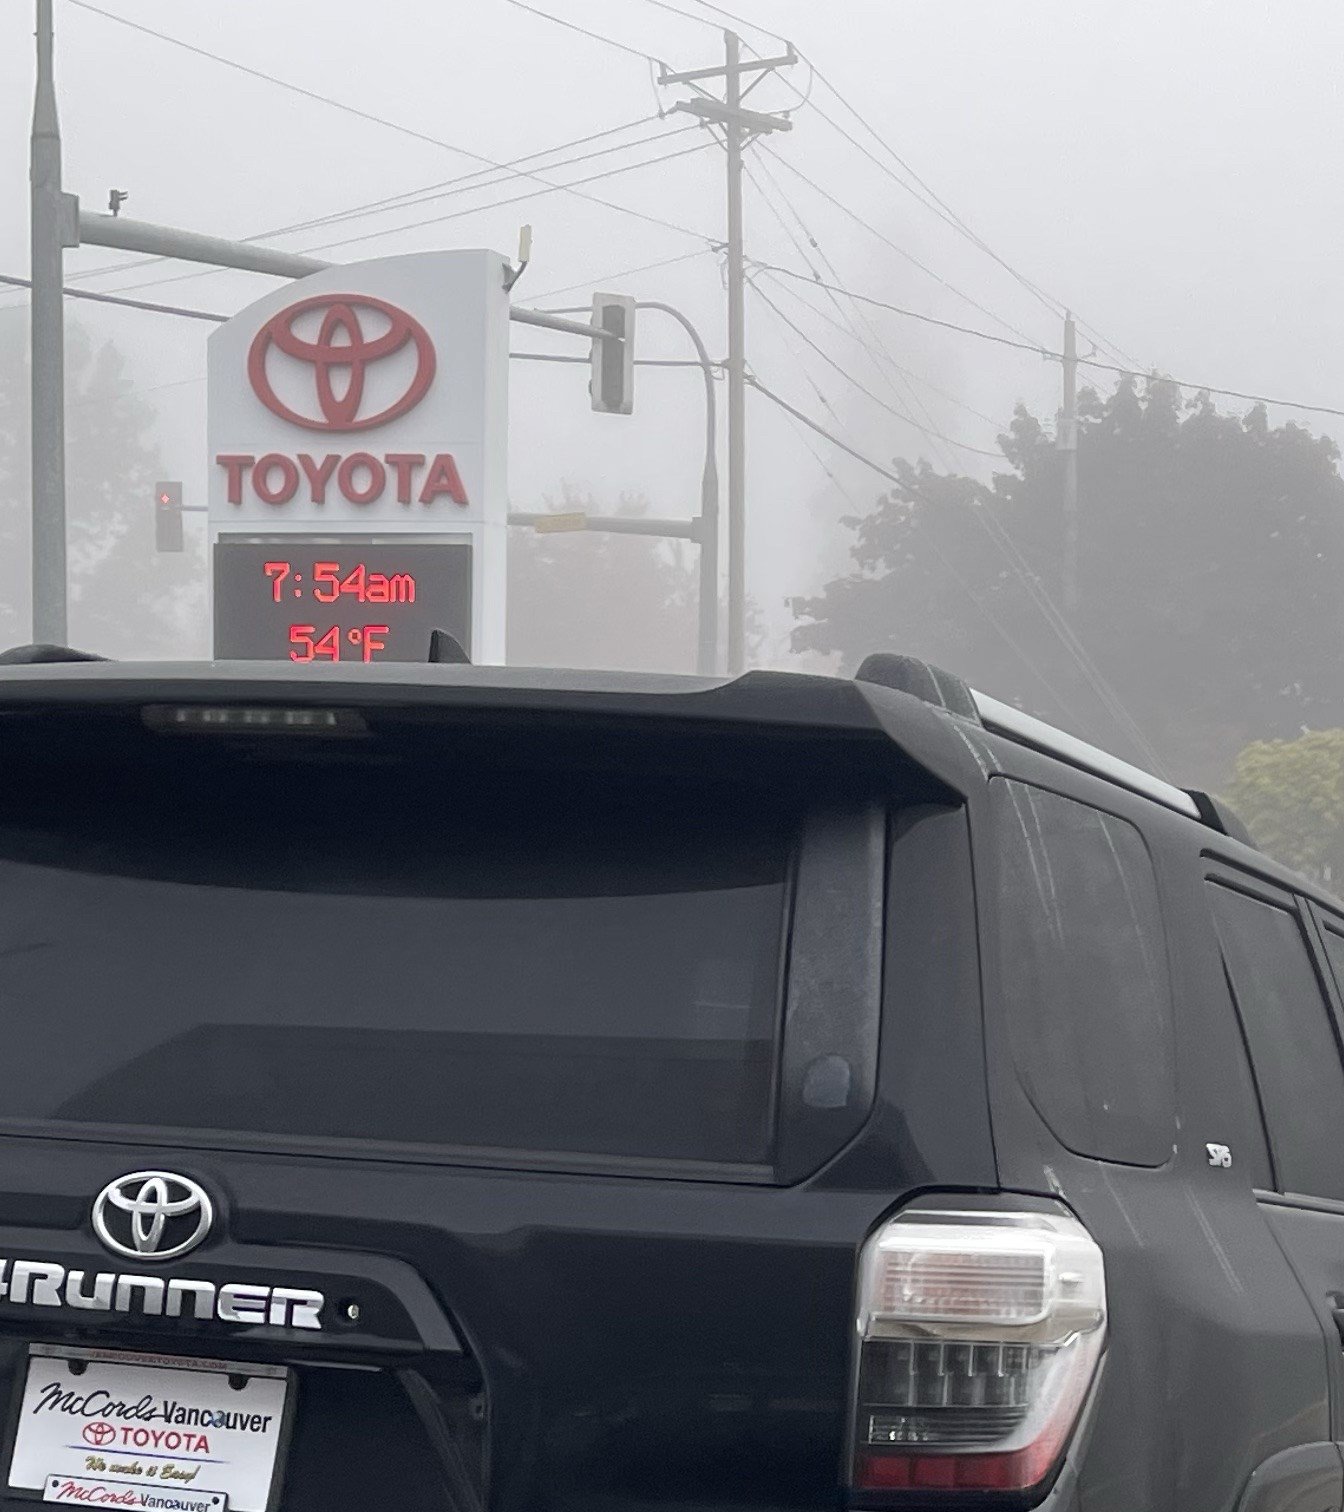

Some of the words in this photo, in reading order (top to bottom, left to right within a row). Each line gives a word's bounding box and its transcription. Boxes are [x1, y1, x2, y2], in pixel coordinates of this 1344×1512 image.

[216, 452, 469, 506] TOYOTA
[264, 562, 416, 603] 7:54am
[33, 1382, 165, 1422] McCords
[163, 1400, 272, 1433] Vancouver
[121, 1426, 211, 1454] TOYOTA
[57, 1480, 142, 1505] McCords
